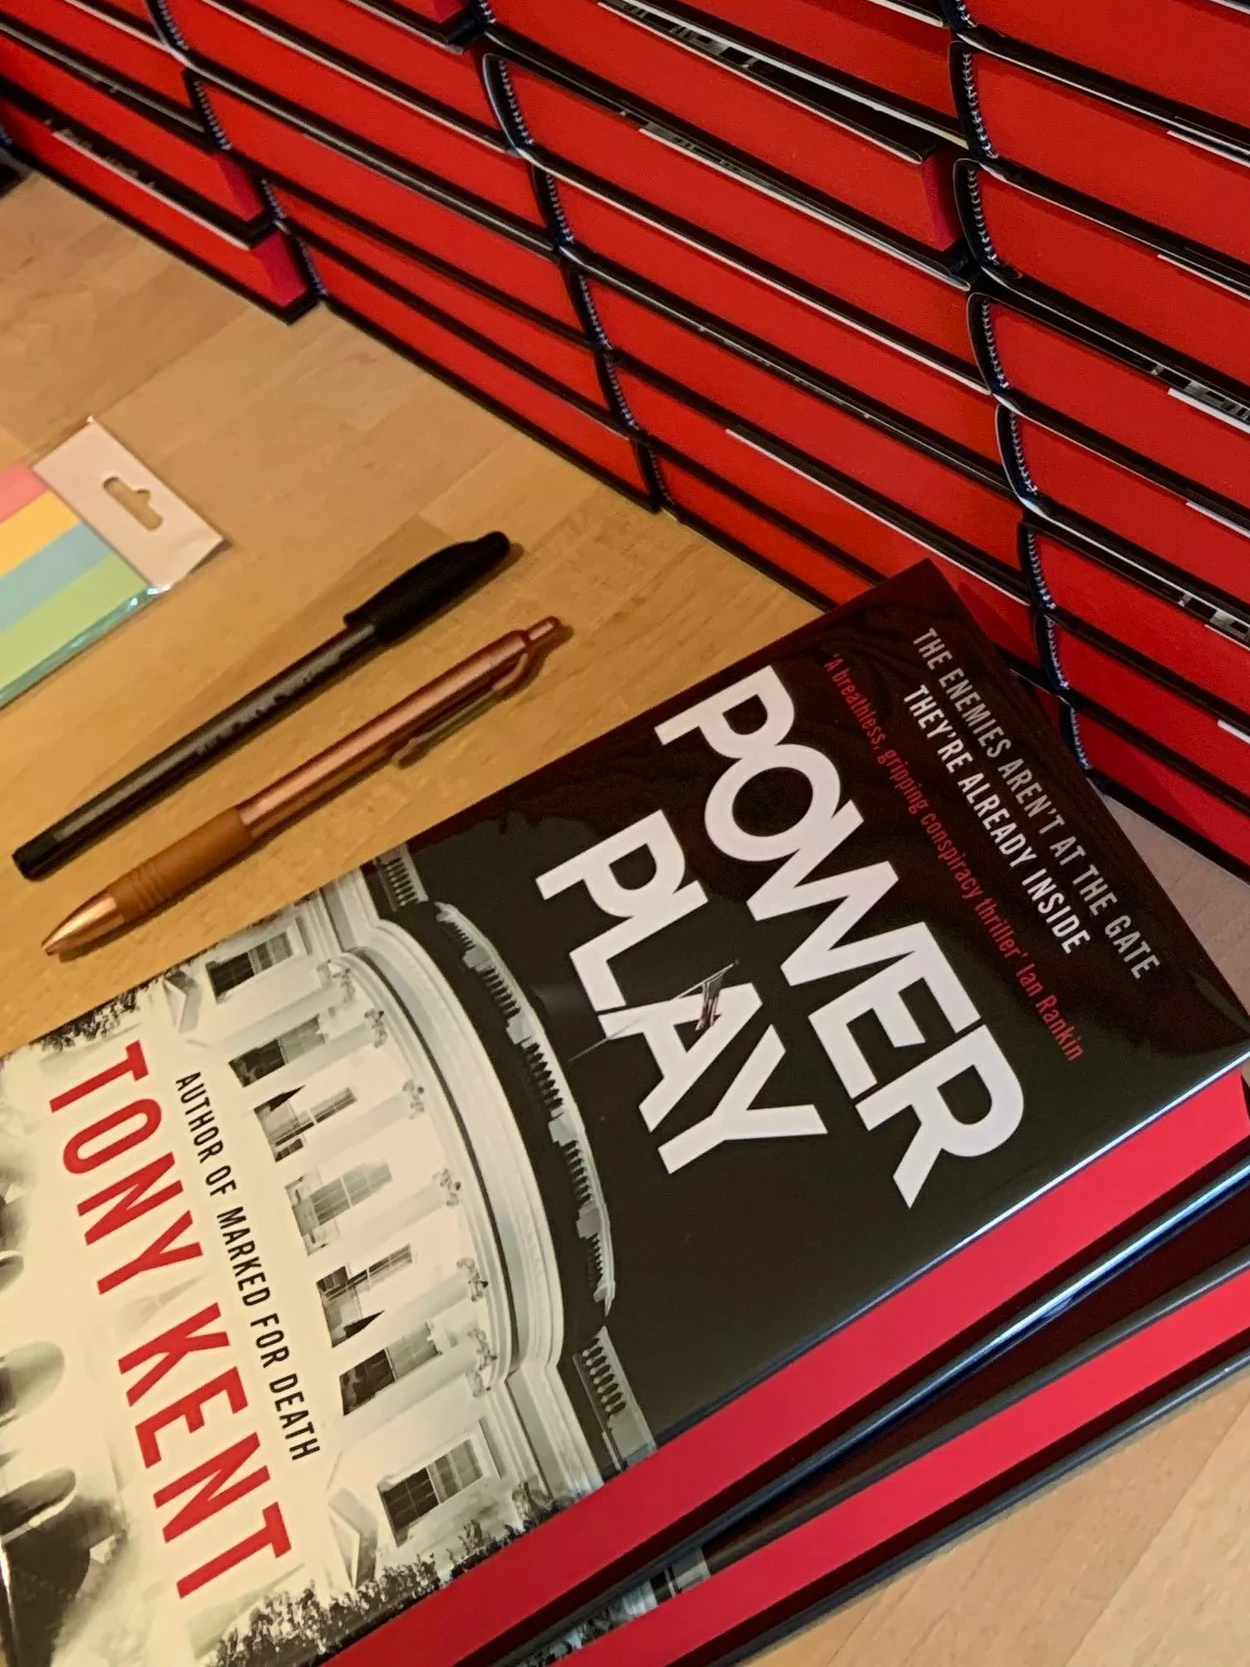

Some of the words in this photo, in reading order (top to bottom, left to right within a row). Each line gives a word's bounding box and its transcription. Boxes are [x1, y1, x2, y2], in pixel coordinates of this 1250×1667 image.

[875, 746, 932, 815] gripping
[916, 811, 986, 902] conspiracy
[1013, 962, 1048, 998] Ian
[1033, 993, 1089, 1062] Rankin
[904, 685, 972, 772] THEY'RE
[958, 773, 1036, 867] ALREADY
[1022, 869, 1089, 953] INSIDE
[914, 628, 951, 669] THE
[939, 669, 1010, 757] ENEMIES
[998, 759, 1064, 833] AREN'T
[1050, 837, 1085, 865] AT
[1072, 865, 1116, 915] THE
[1105, 916, 1159, 978] GATE
[536, 810, 826, 1173] PLAY
[655, 666, 1023, 1208] POWER
[49, 1041, 201, 1293] TONY
[176, 1072, 222, 1162] AUTHOR
[206, 1166, 235, 1195] OF
[217, 1207, 269, 1305] MARKED
[250, 1314, 288, 1367] FOR
[118, 1304, 290, 1597] KENT
[269, 1374, 319, 1460] DEATH
